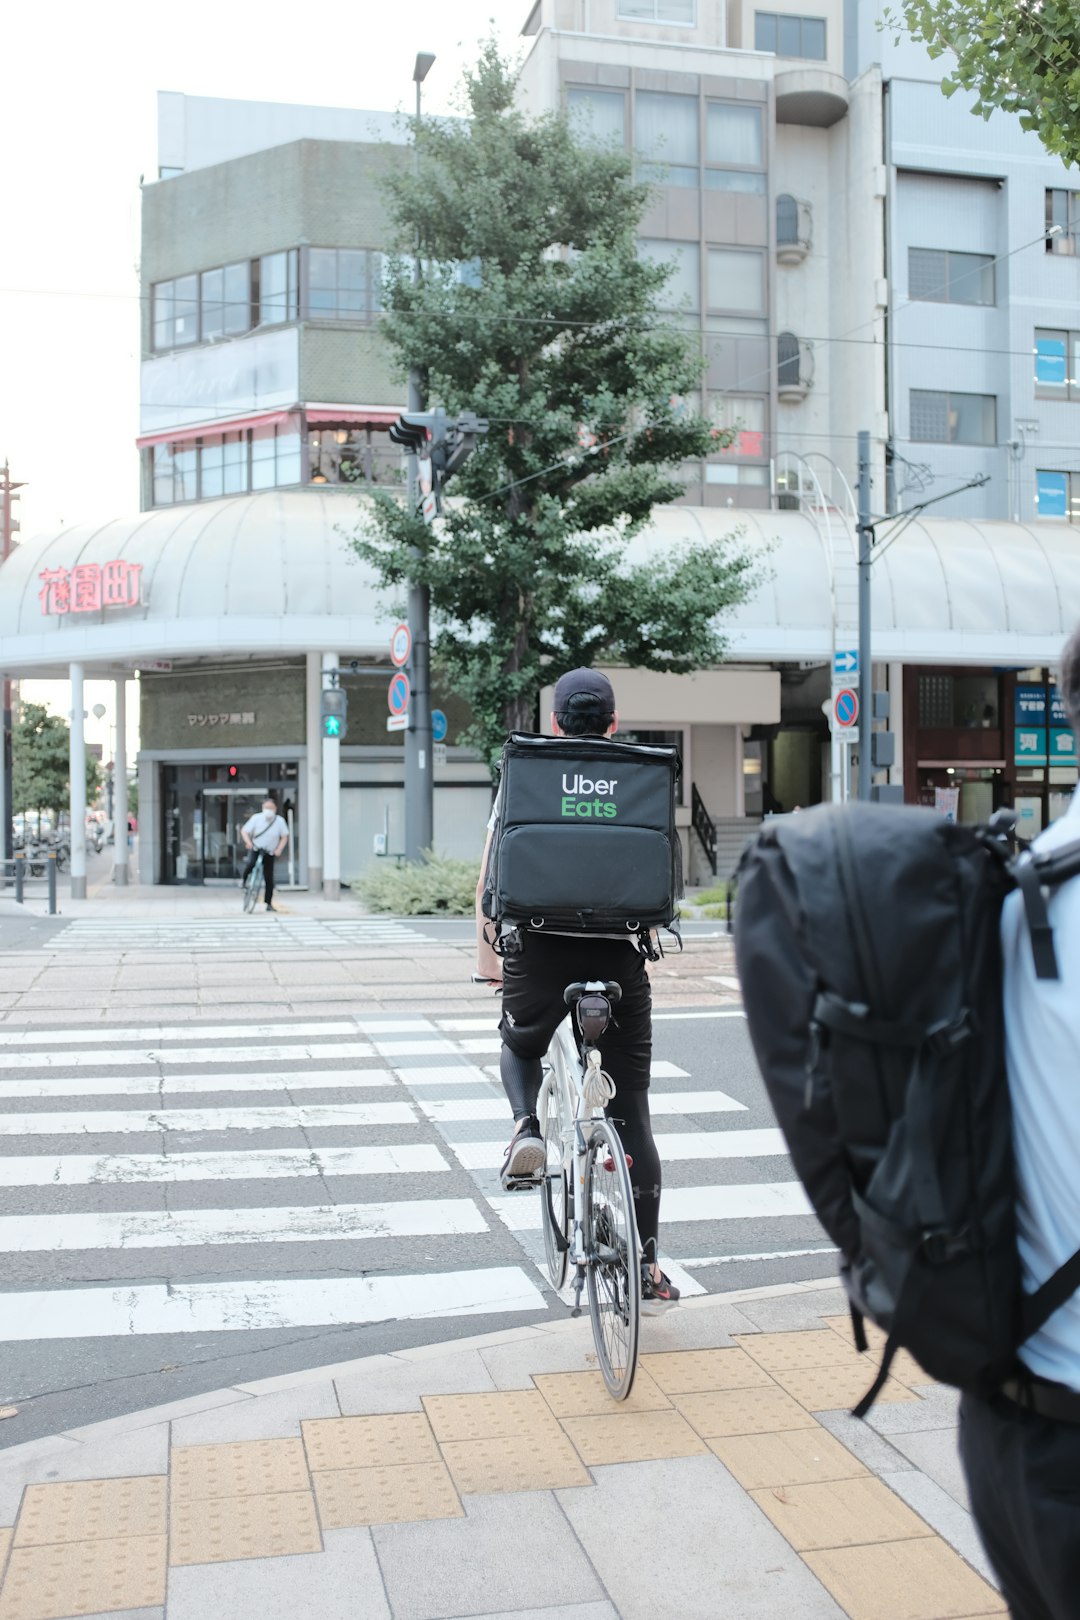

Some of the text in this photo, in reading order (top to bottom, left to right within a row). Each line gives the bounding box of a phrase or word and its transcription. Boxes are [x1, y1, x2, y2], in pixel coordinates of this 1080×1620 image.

[38, 560, 143, 615] 花園町
[562, 774, 618, 795] Uber
[561, 796, 617, 818] Eats
